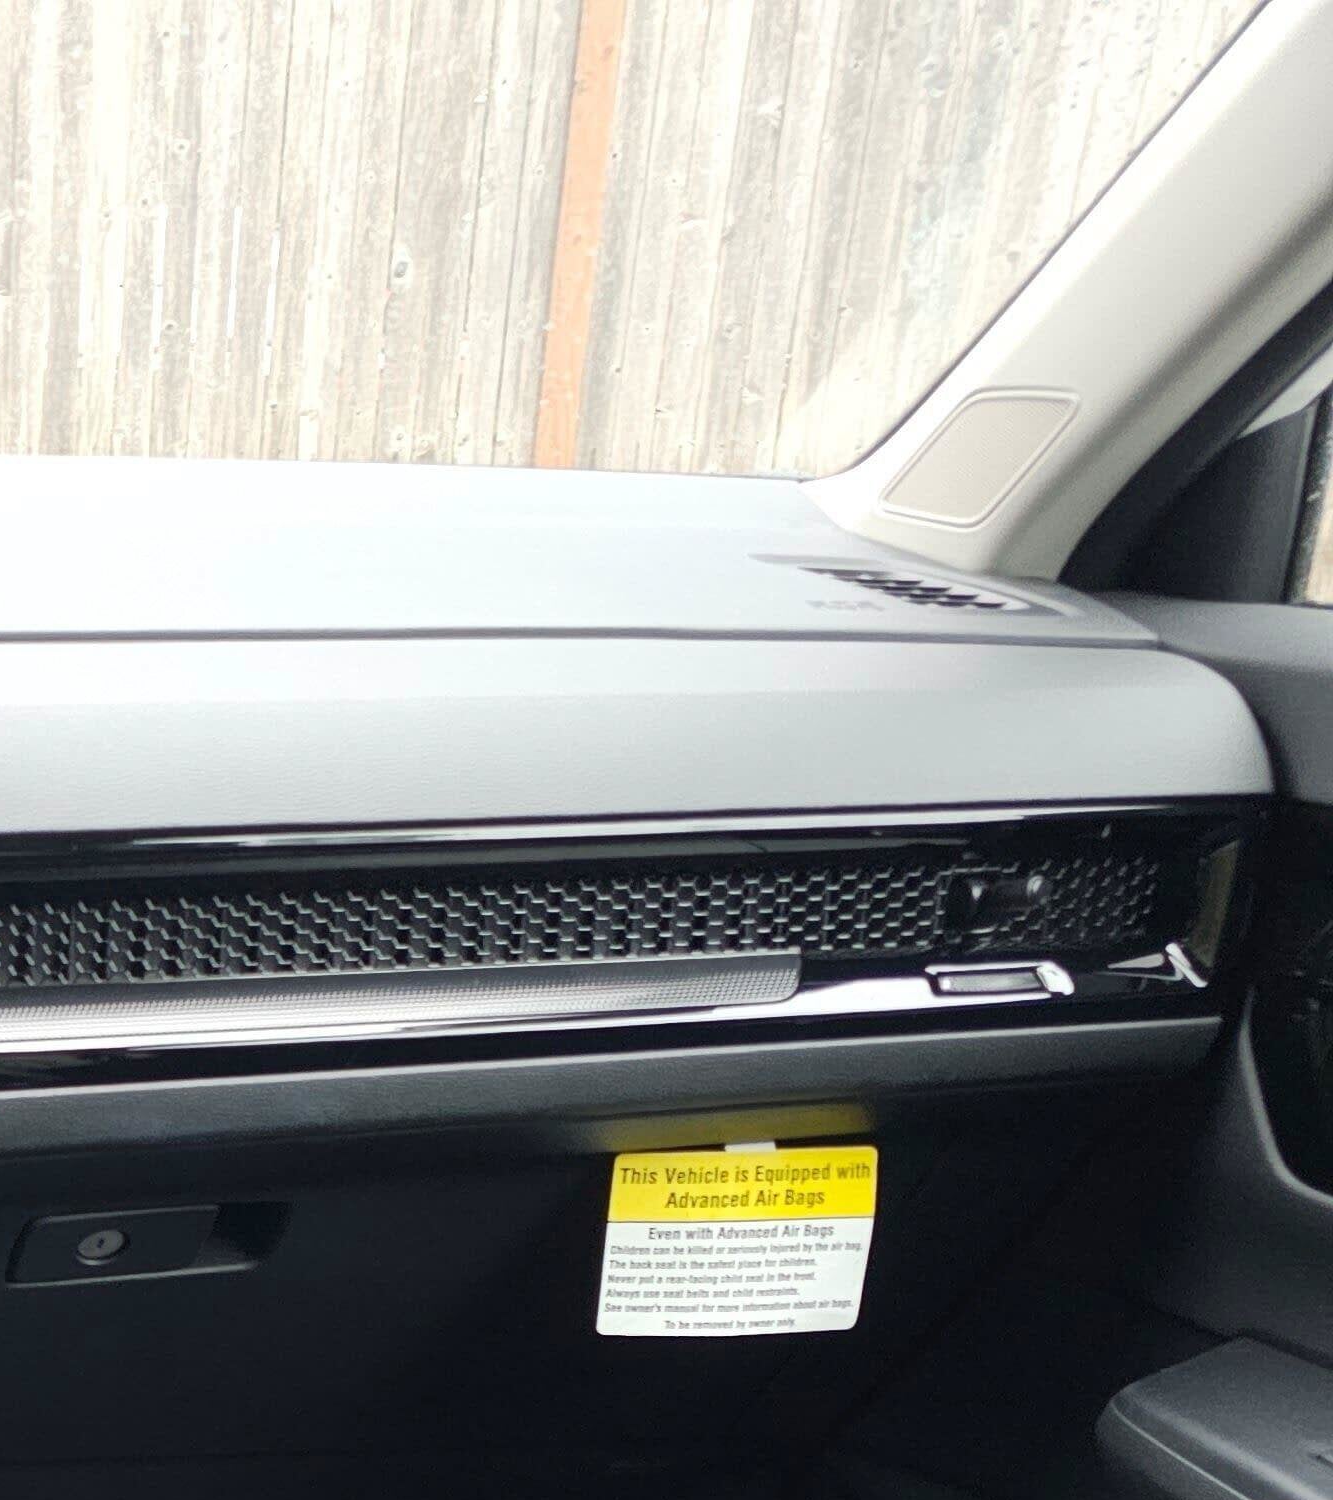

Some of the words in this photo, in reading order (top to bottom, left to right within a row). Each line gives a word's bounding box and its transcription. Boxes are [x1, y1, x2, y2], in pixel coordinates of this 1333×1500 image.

[619, 1168, 658, 1185] This
[664, 1166, 730, 1184] Vehicle
[734, 1166, 749, 1182] is
[754, 1164, 831, 1186] Equipped
[836, 1162, 871, 1180] with
[664, 1190, 750, 1209] Advanced
[754, 1190, 780, 1207] Air
[784, 1189, 826, 1208] Bags
[648, 1226, 682, 1240] Even
[685, 1226, 714, 1240] with
[717, 1225, 779, 1240] Advanced
[782, 1225, 800, 1238] Air
[804, 1224, 835, 1239] Bags
[609, 1260, 627, 1269] The
[605, 1288, 640, 1300] Always
[604, 1302, 622, 1312] See
[664, 1320, 676, 1329] To
